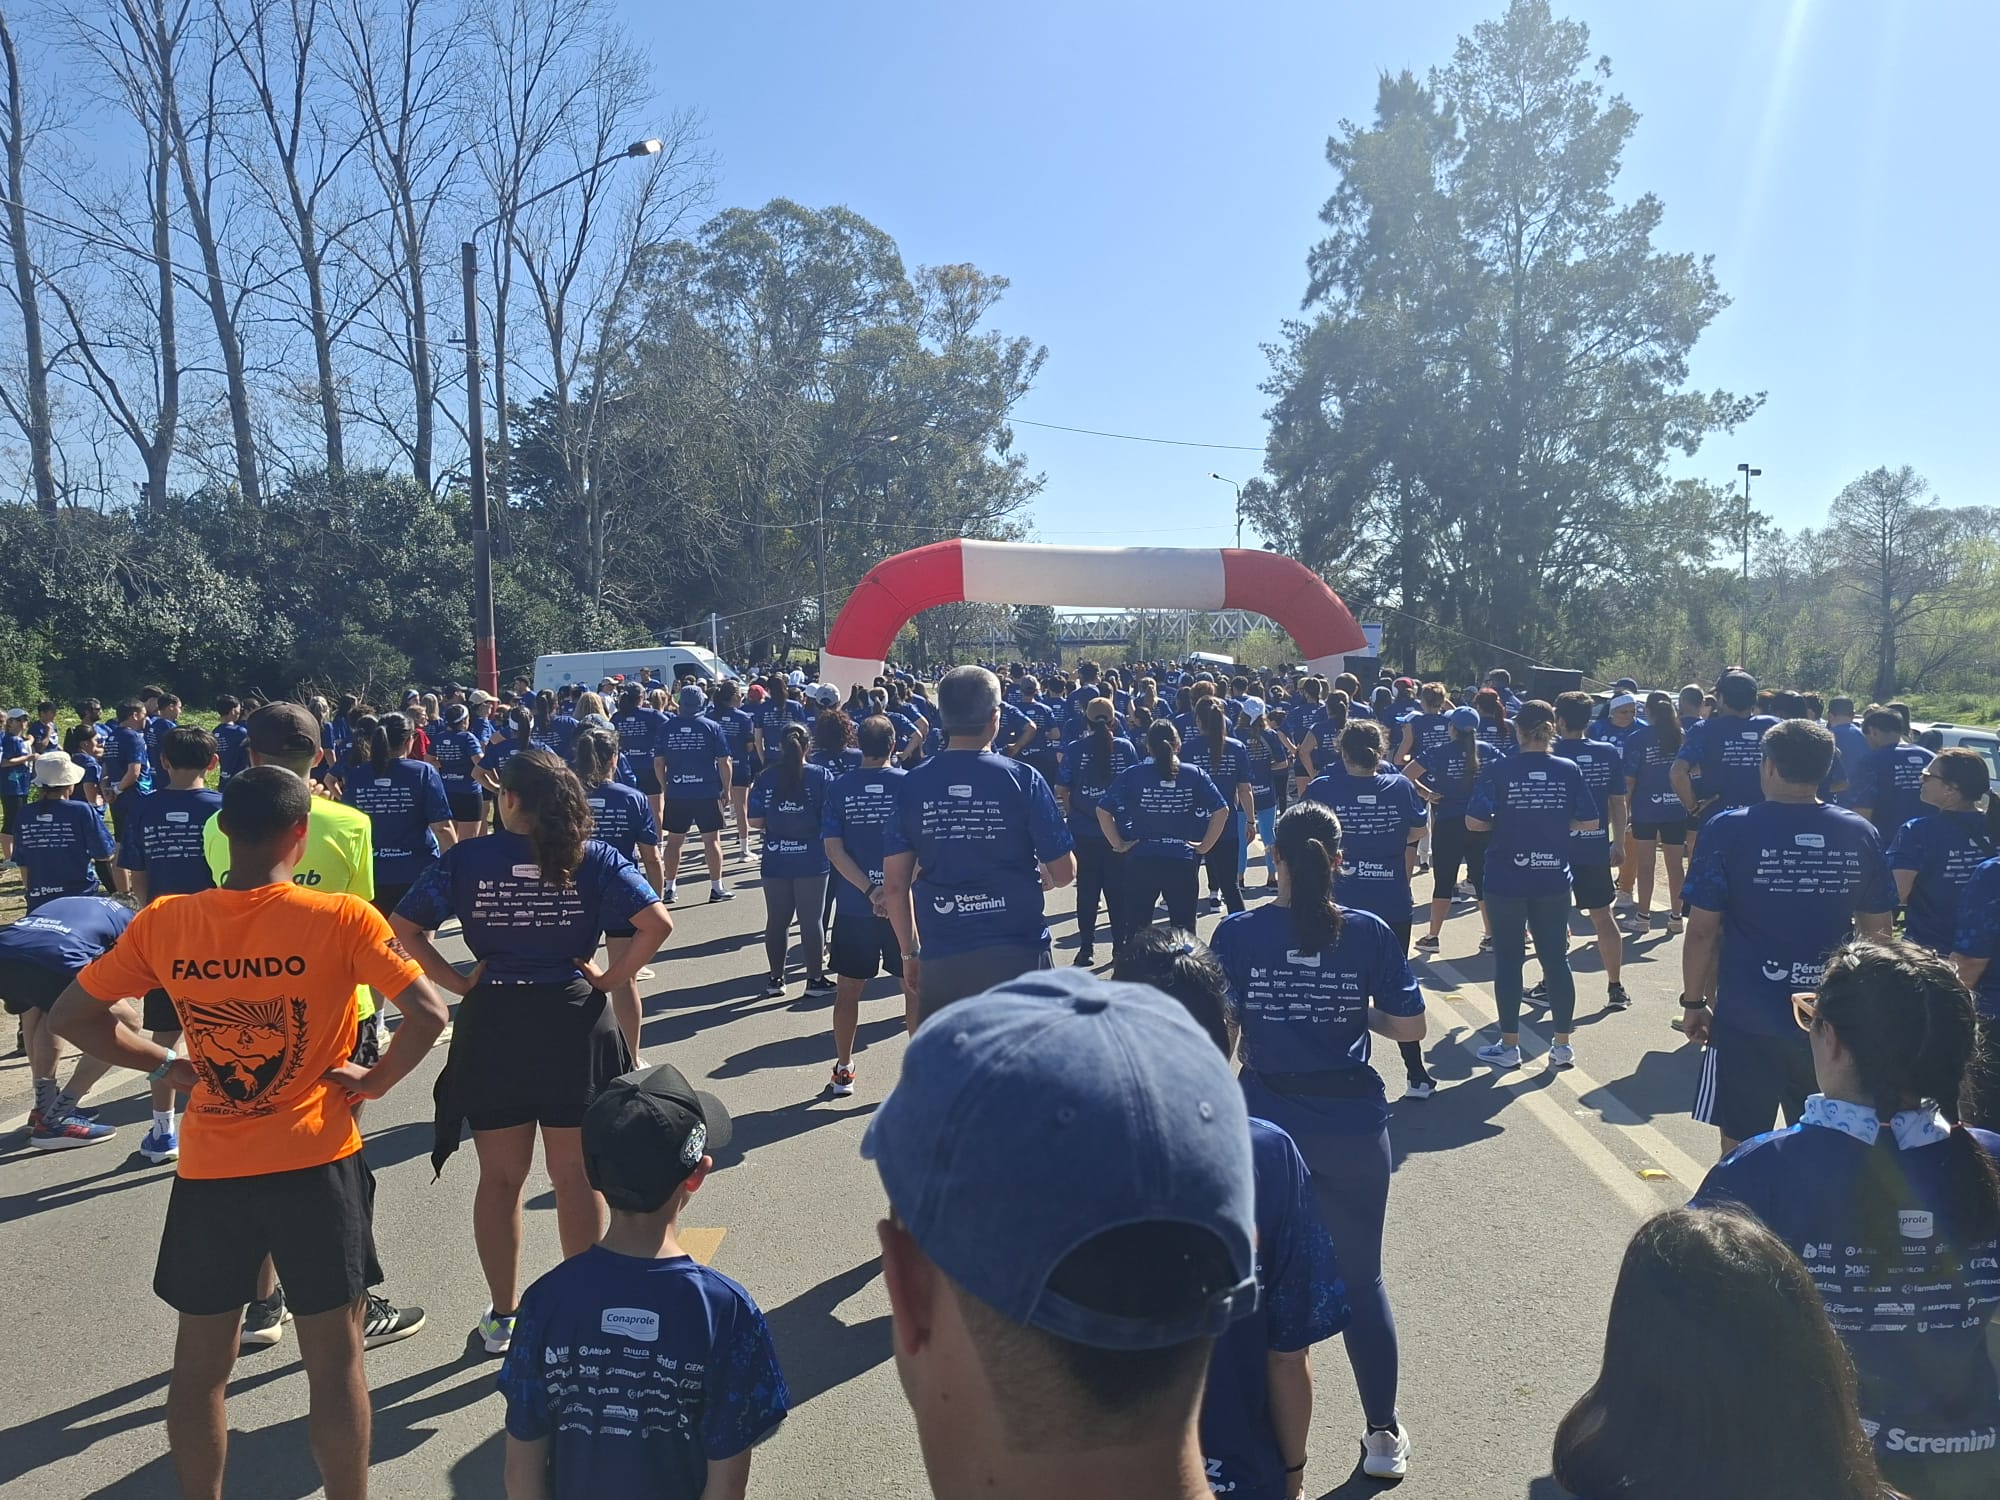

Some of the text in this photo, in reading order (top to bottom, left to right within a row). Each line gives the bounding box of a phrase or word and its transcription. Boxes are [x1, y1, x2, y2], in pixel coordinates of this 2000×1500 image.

[1530, 852, 1554, 860] Pérez
[1358, 861, 1384, 870] Pérez
[1357, 869, 1394, 877] Scremini
[41, 886, 65, 896] Pérez
[955, 893, 989, 903] Pérez
[957, 897, 1006, 914] Scremini
[36, 917, 62, 925] Pérez
[30, 922, 72, 935] Scremini
[171, 955, 307, 981] FACUNDO
[1805, 1264, 1836, 1275] reditel
[606, 1313, 655, 1327] Conaprole
[1961, 1316, 1980, 1329] ute
[1886, 1426, 1996, 1453] Scremini
